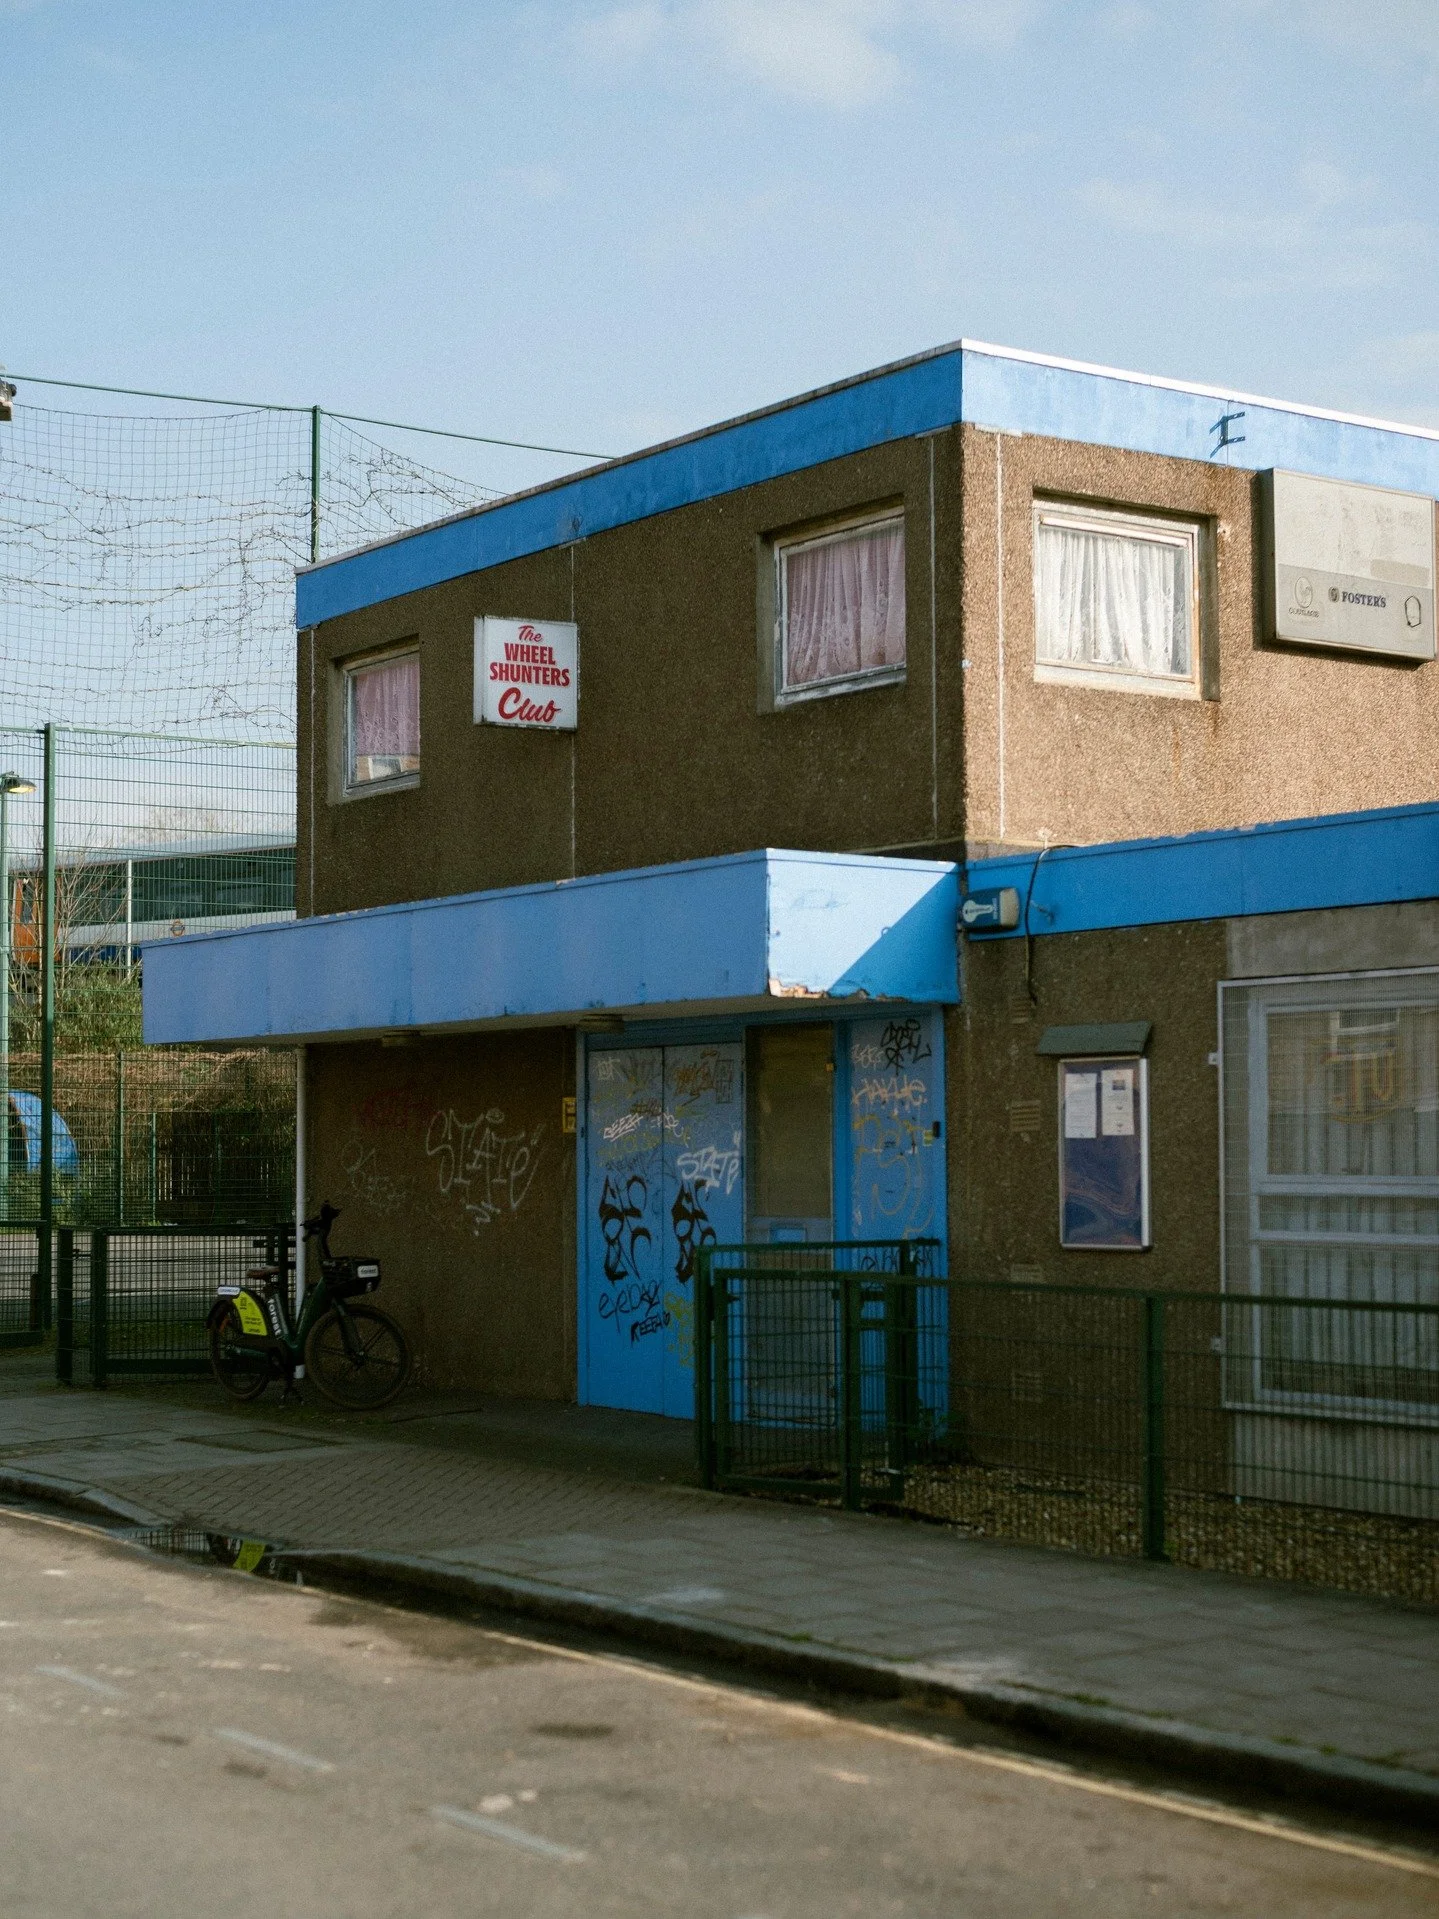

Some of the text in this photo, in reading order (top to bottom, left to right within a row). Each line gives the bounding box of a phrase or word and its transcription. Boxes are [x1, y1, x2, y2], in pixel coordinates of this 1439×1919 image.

[1341, 591, 1387, 608] FOSTER'S
[518, 625, 543, 642] The
[504, 643, 556, 665] WHEEL
[489, 662, 570, 687] SHUNTERS
[498, 687, 562, 722] Club
